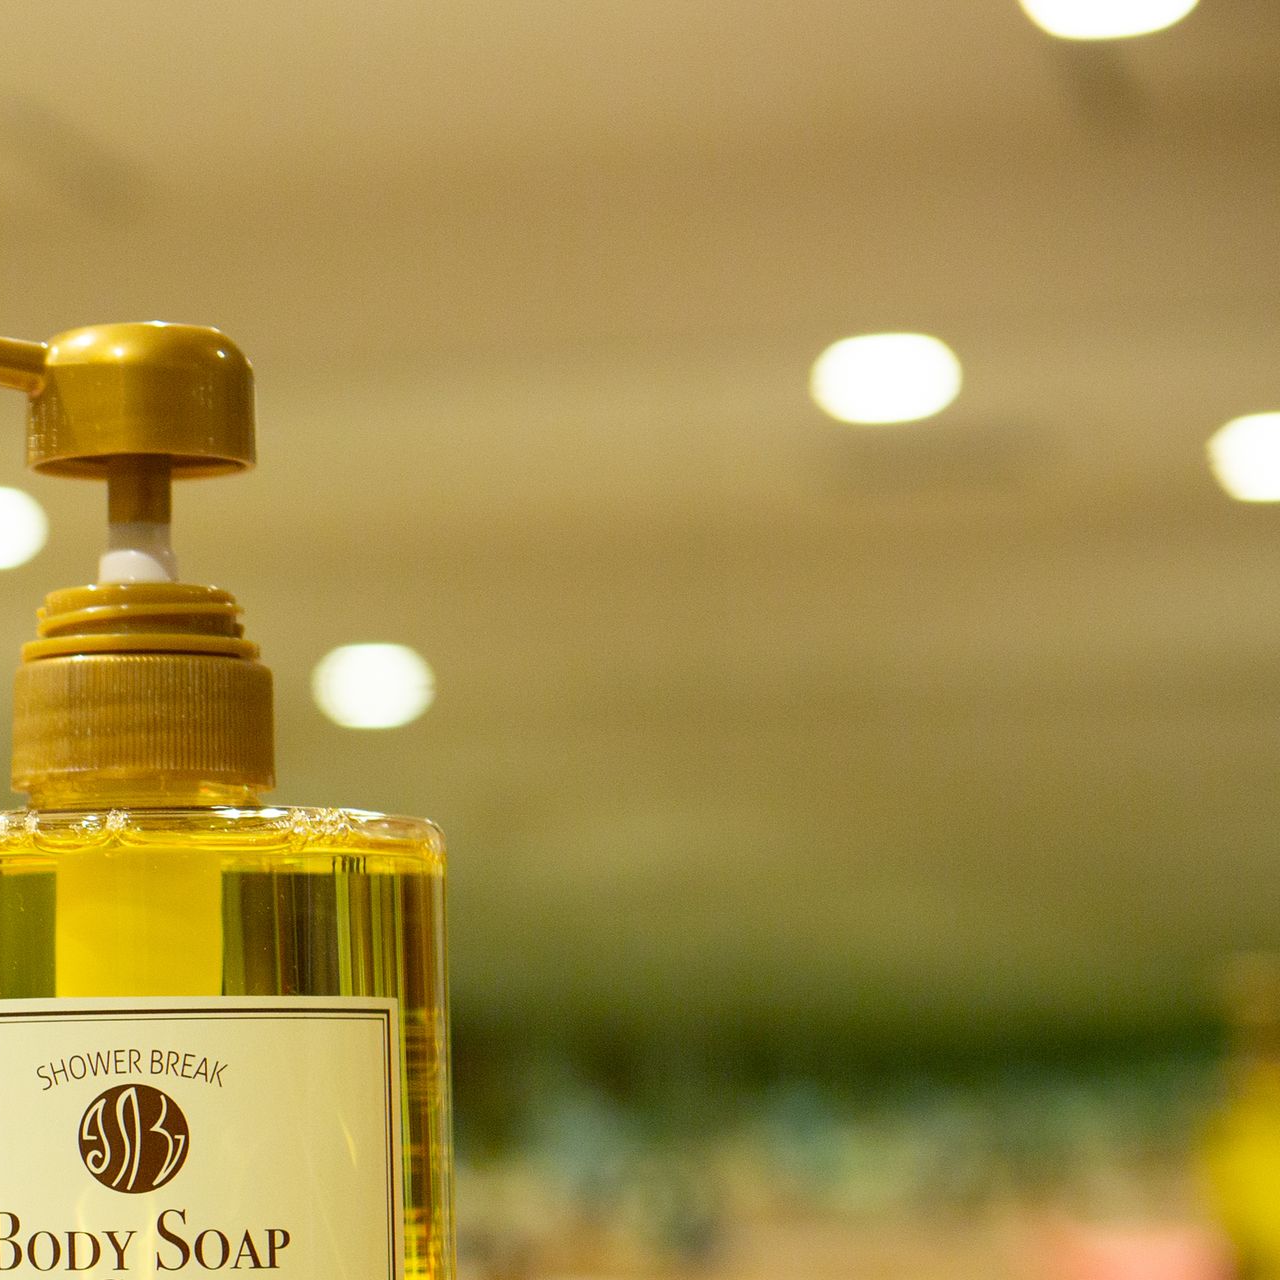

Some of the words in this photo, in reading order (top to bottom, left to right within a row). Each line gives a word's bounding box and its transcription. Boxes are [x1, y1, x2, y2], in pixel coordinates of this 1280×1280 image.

[36, 1049, 142, 1091] SHOWER
[150, 1049, 228, 1087] BREAK
[155, 1208, 291, 1271] SOAP
